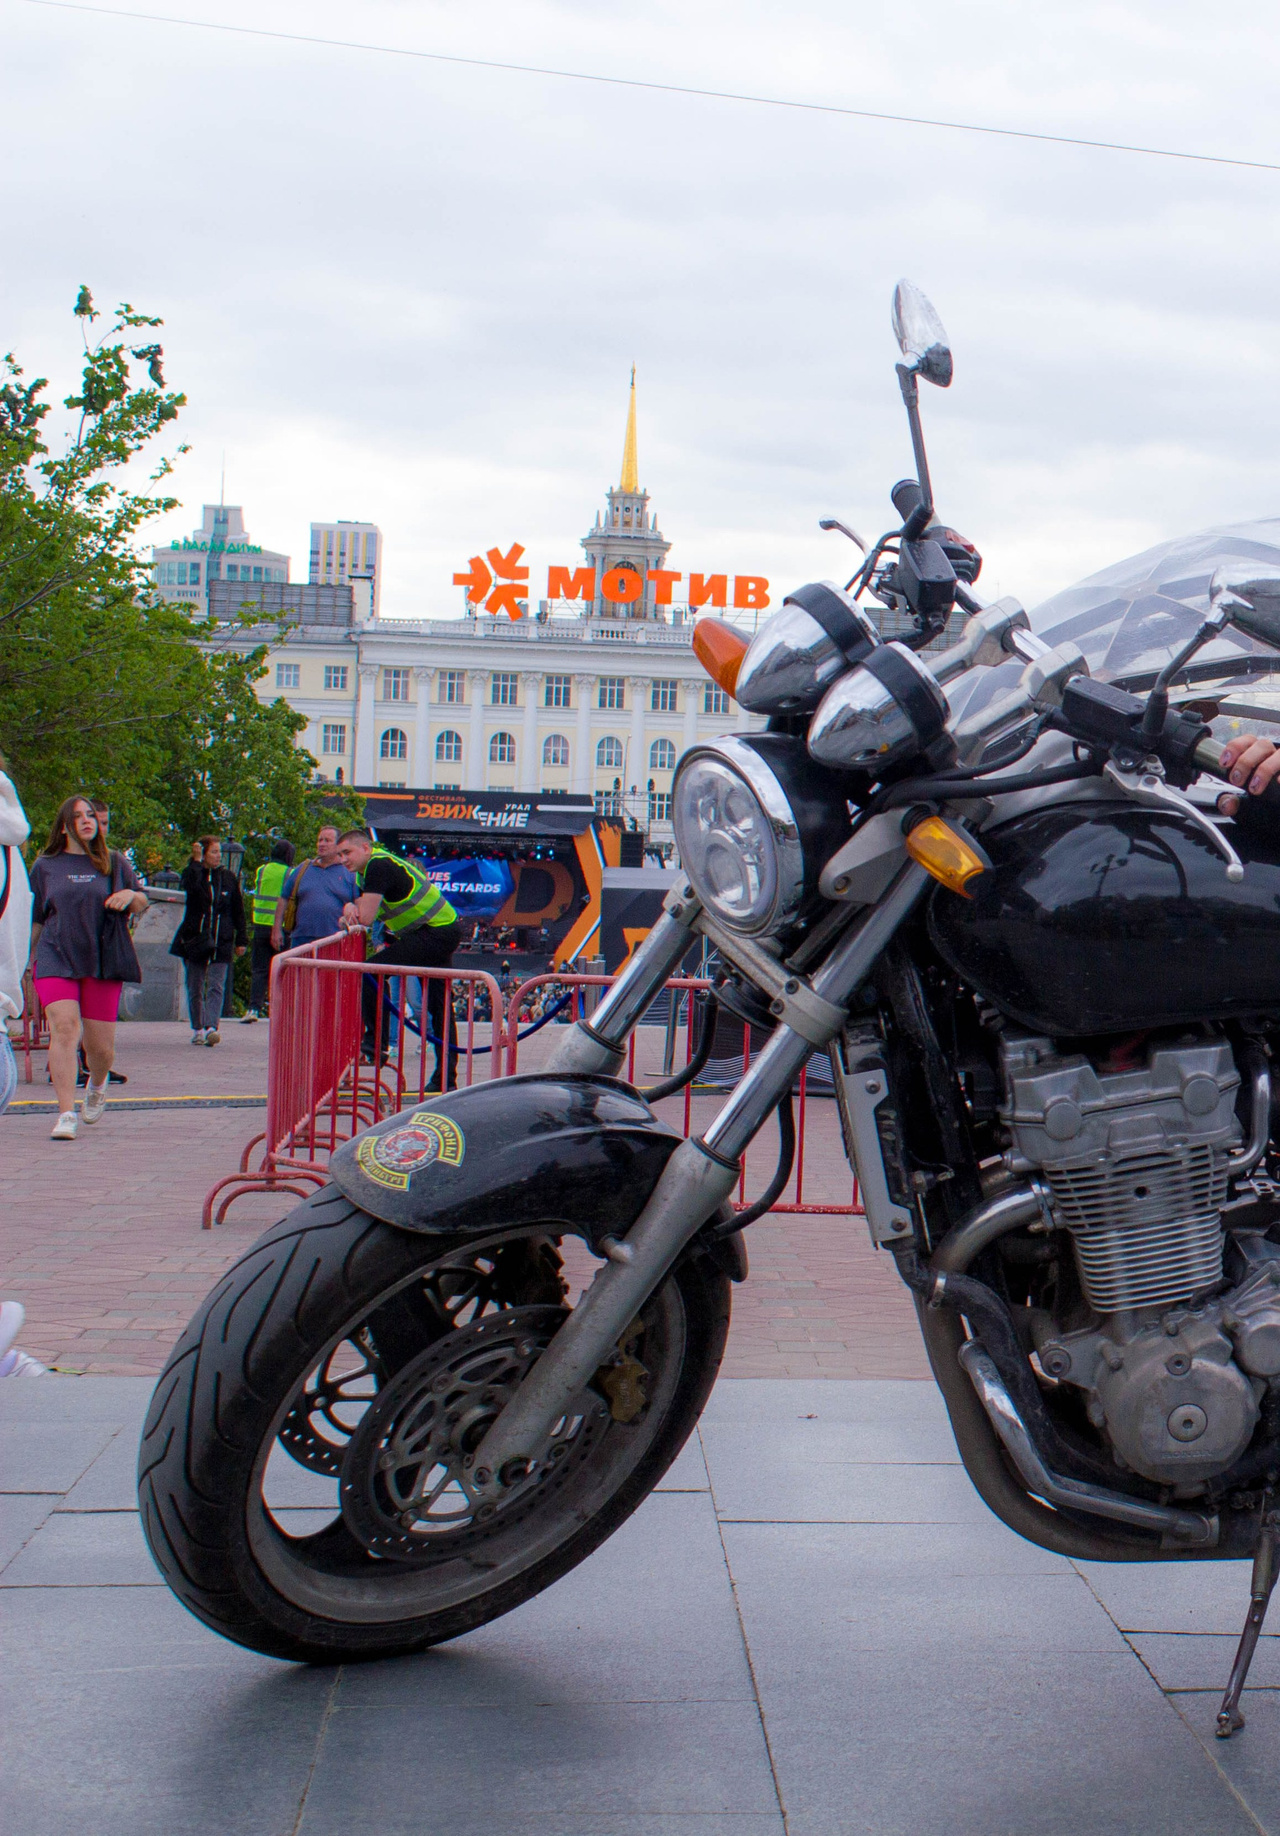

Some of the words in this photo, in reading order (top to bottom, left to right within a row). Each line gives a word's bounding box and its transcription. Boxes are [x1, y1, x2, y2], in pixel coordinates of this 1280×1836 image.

[547, 566, 771, 609] МОТИВ
[504, 803, 531, 811] УРАЛ
[427, 871, 451, 881] UES
[434, 882, 501, 893] BASTARDS
[418, 1115, 458, 1157] ГРИФОНЫ
